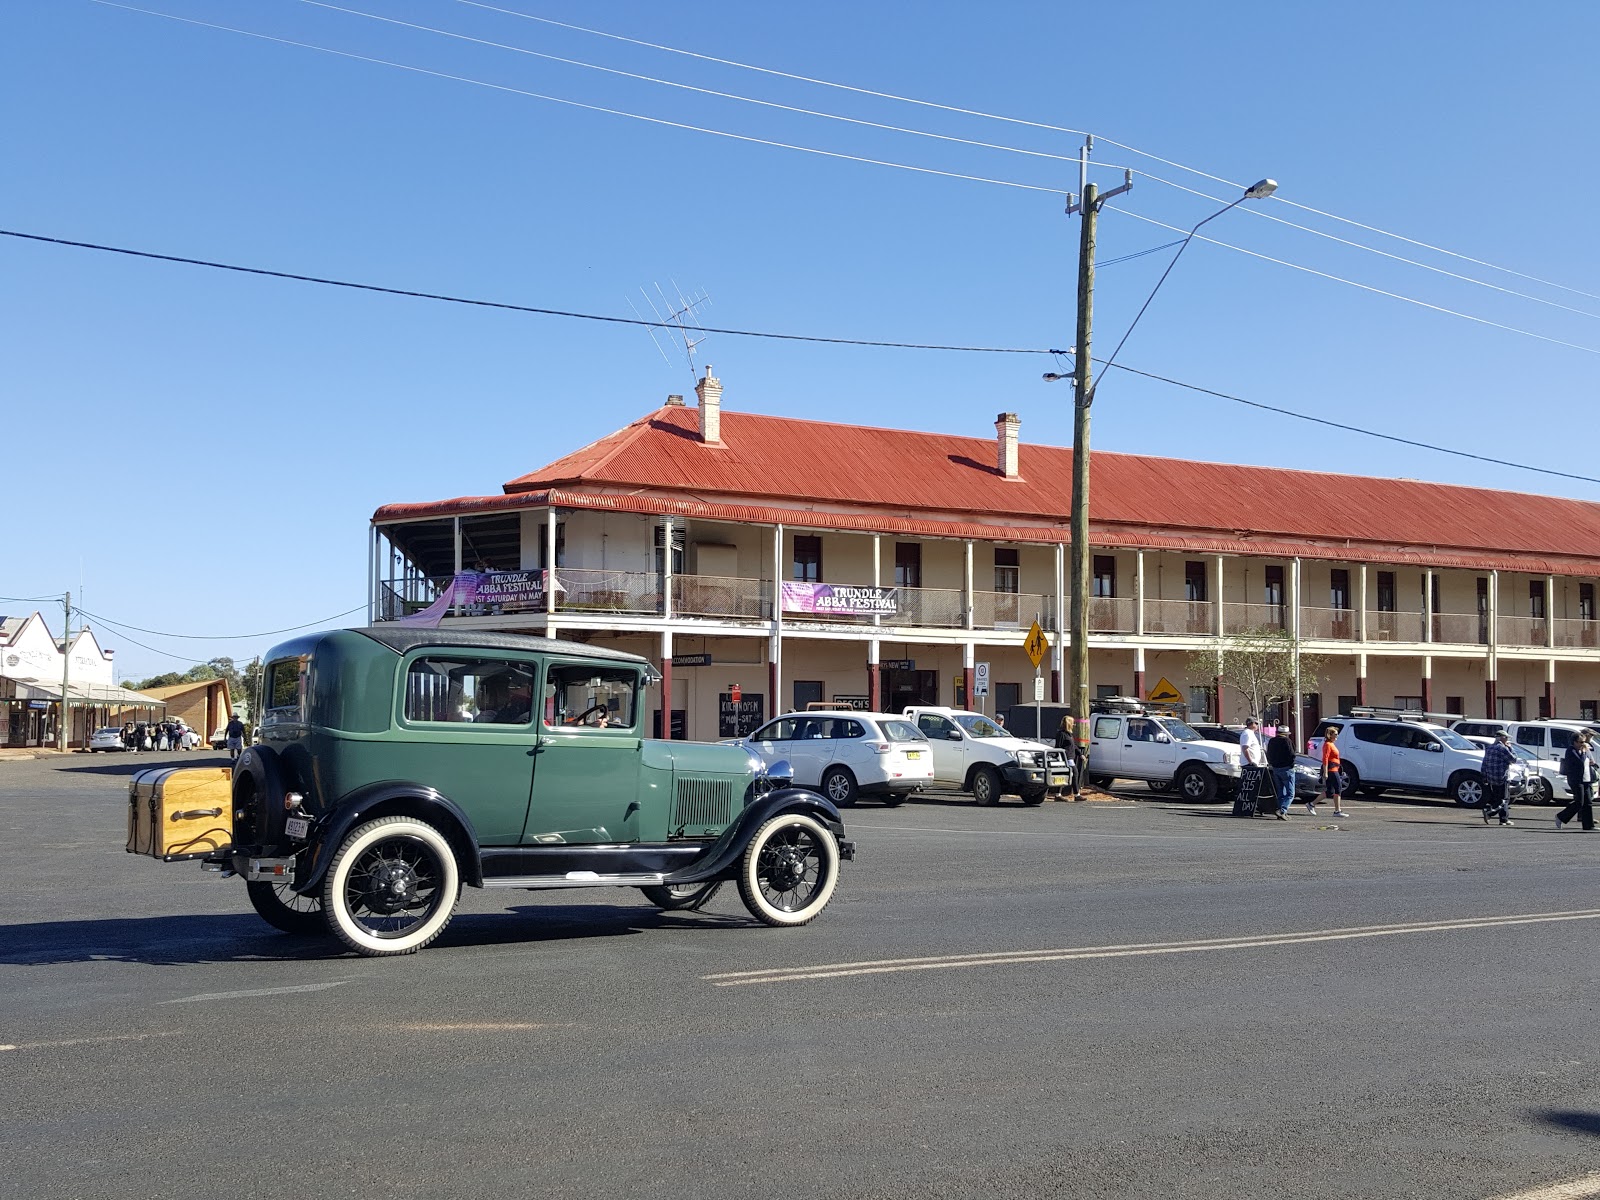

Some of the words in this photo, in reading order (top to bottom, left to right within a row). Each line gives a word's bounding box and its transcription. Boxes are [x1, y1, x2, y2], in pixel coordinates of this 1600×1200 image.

[491, 573, 528, 584] TRUNDLE
[476, 584, 501, 593] ABBA
[503, 581, 542, 592] FESTIVAL
[487, 593, 518, 603] SATURDAY
[528, 592, 542, 600] MAY
[833, 587, 882, 599] TRUNDLE
[815, 597, 848, 607] ABBA
[849, 598, 897, 609] FESTIVAL
[721, 702, 743, 712] KITCHN
[1241, 769, 1261, 780] PIZZA
[1242, 780, 1255, 792] $15
[1237, 792, 1250, 801] ALL
[1242, 802, 1255, 812] DAY
